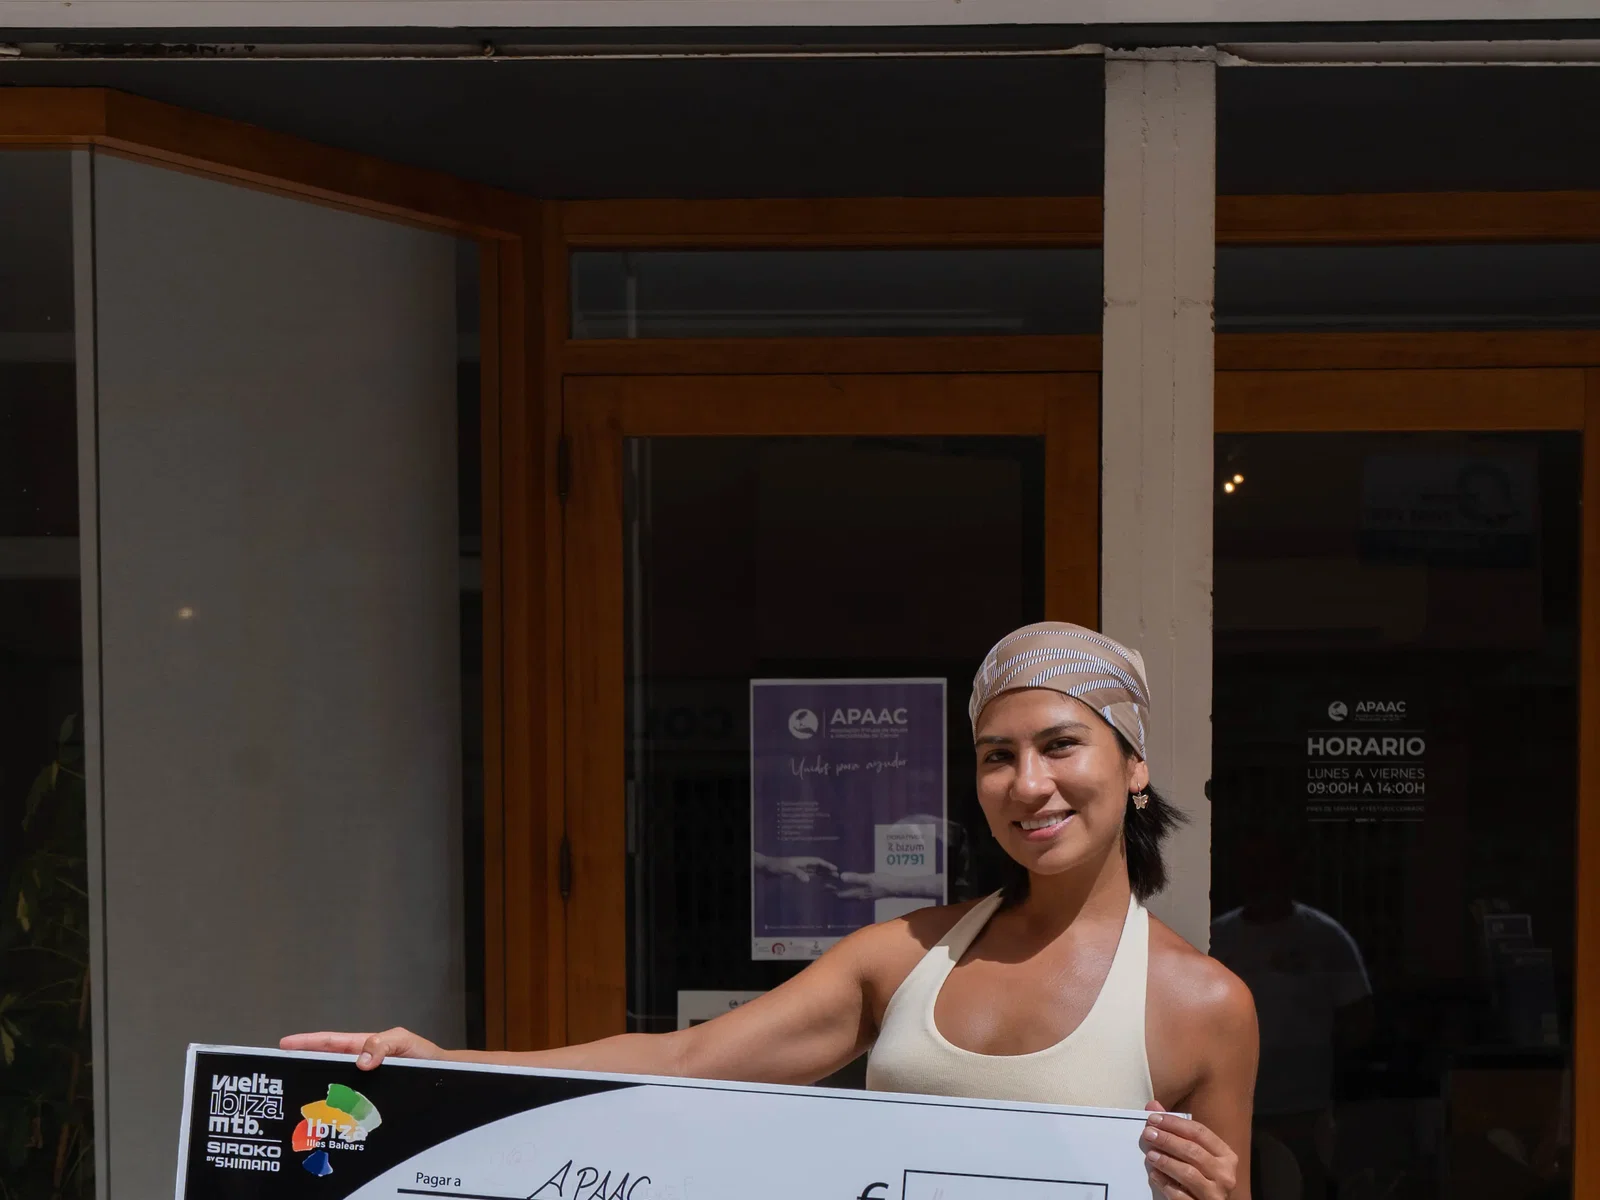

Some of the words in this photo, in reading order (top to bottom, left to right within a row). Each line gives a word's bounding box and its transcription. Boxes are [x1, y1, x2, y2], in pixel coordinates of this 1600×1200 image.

[1355, 700, 1407, 713] APAAC
[830, 707, 909, 725] APAAC
[1307, 736, 1426, 756] HORARIO
[1307, 768, 1350, 780] LUNES
[1354, 768, 1365, 780] A
[1369, 768, 1426, 780] VIERNES
[1307, 782, 1359, 794] 09:00H
[1362, 782, 1374, 794] A
[1377, 782, 1426, 795] 14:00H
[896, 842, 925, 852] bizum
[886, 853, 925, 866] 01791
[208, 1115, 265, 1136] mtb.
[306, 1117, 369, 1142] Ibiza
[206, 1140, 283, 1159] SIROKO
[306, 1138, 326, 1150] Illes
[328, 1140, 365, 1152] Balears
[214, 1156, 281, 1173] SHIMANO
[415, 1171, 453, 1188] Pagar
[454, 1176, 462, 1187] a
